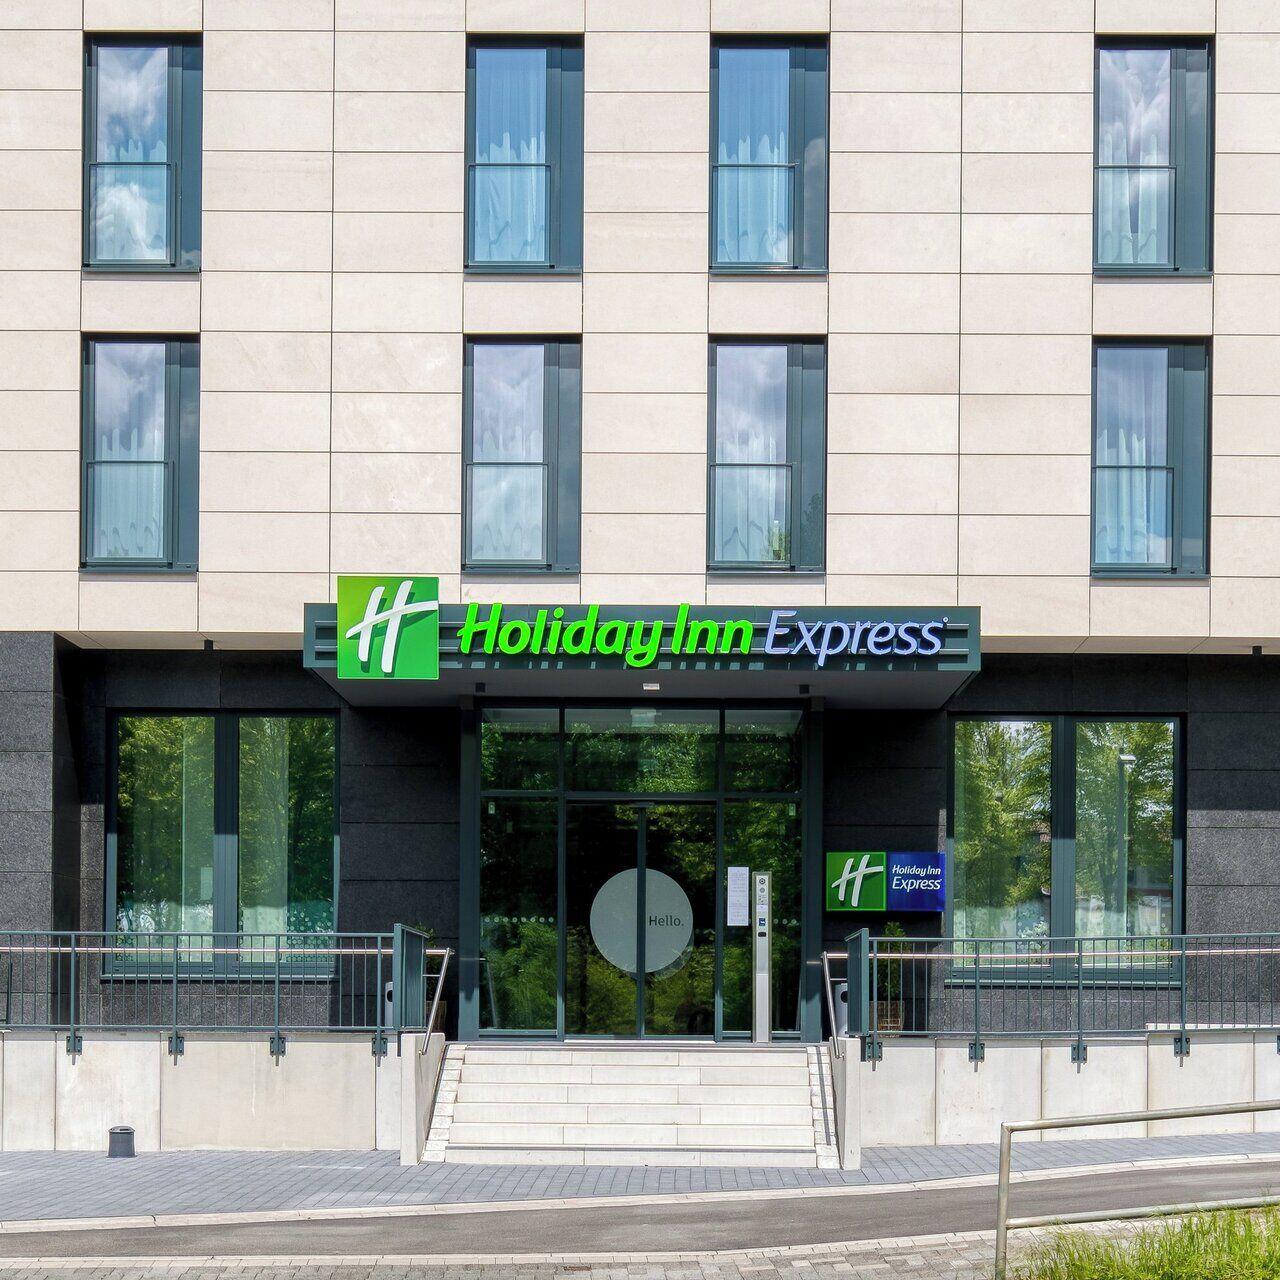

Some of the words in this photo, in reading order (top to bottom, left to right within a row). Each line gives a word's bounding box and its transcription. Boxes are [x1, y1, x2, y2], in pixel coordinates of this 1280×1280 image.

[456, 602, 664, 668] Holiday
[671, 603, 754, 655] Inn
[892, 864, 927, 877] Holiday
[927, 865, 942, 875] Inn
[649, 914, 685, 927] Hello.
